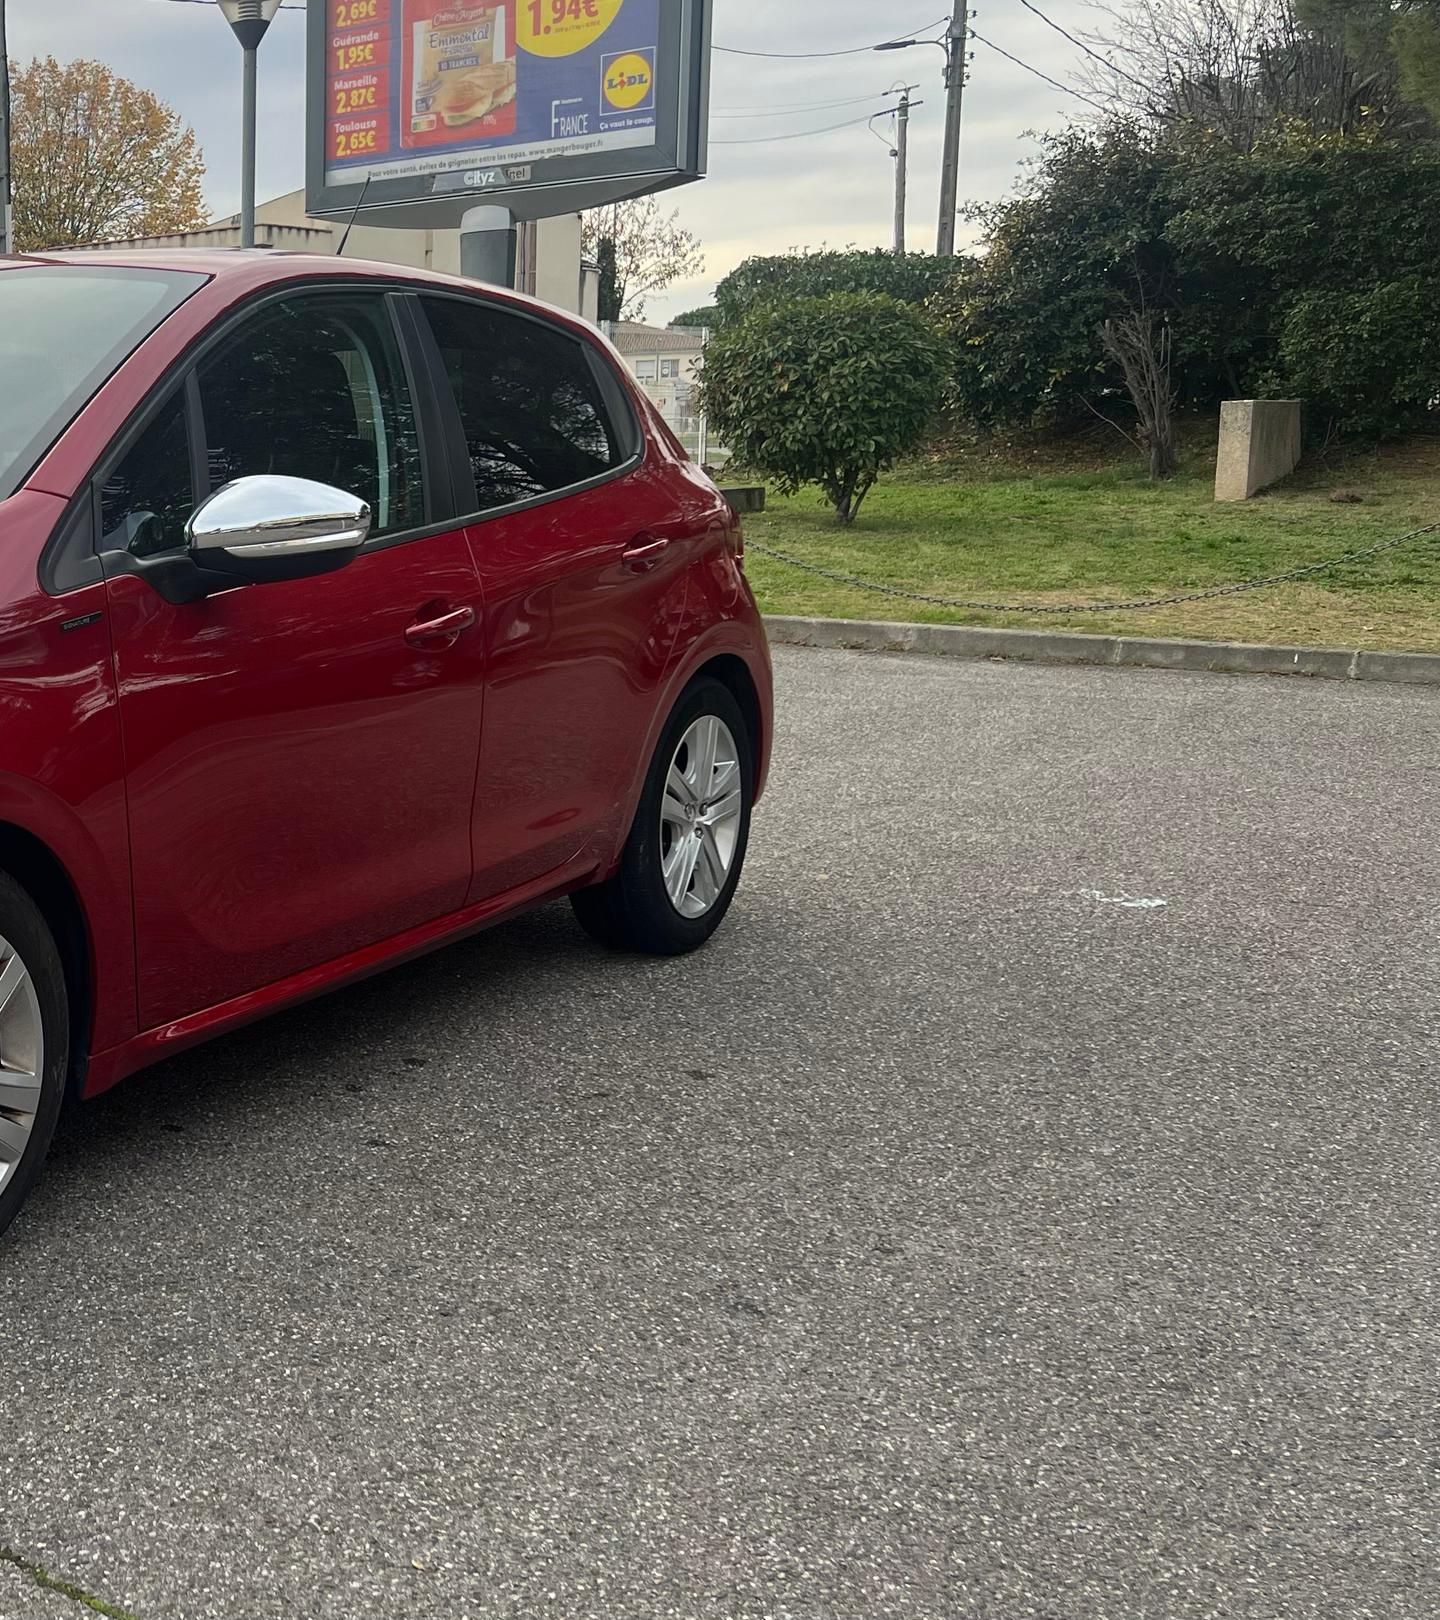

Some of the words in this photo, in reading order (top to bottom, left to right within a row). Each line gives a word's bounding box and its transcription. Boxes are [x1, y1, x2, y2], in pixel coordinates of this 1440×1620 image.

[336, 0, 377, 27] 2.69€
[333, 30, 380, 47] Guérande
[429, 23, 490, 48] Emmental
[336, 43, 374, 70] 1.95€
[334, 74, 378, 90] Marseille
[336, 87, 376, 114] 2.87€
[334, 120, 377, 133] Toulouse
[609, 120, 625, 128] vaut
[336, 130, 376, 156] 2.65€
[383, 169, 399, 177] votre
[419, 162, 437, 171] évitez
[438, 160, 447, 169] de
[447, 157, 478, 169] grignoter
[478, 154, 495, 164] entre
[496, 152, 507, 161] les
